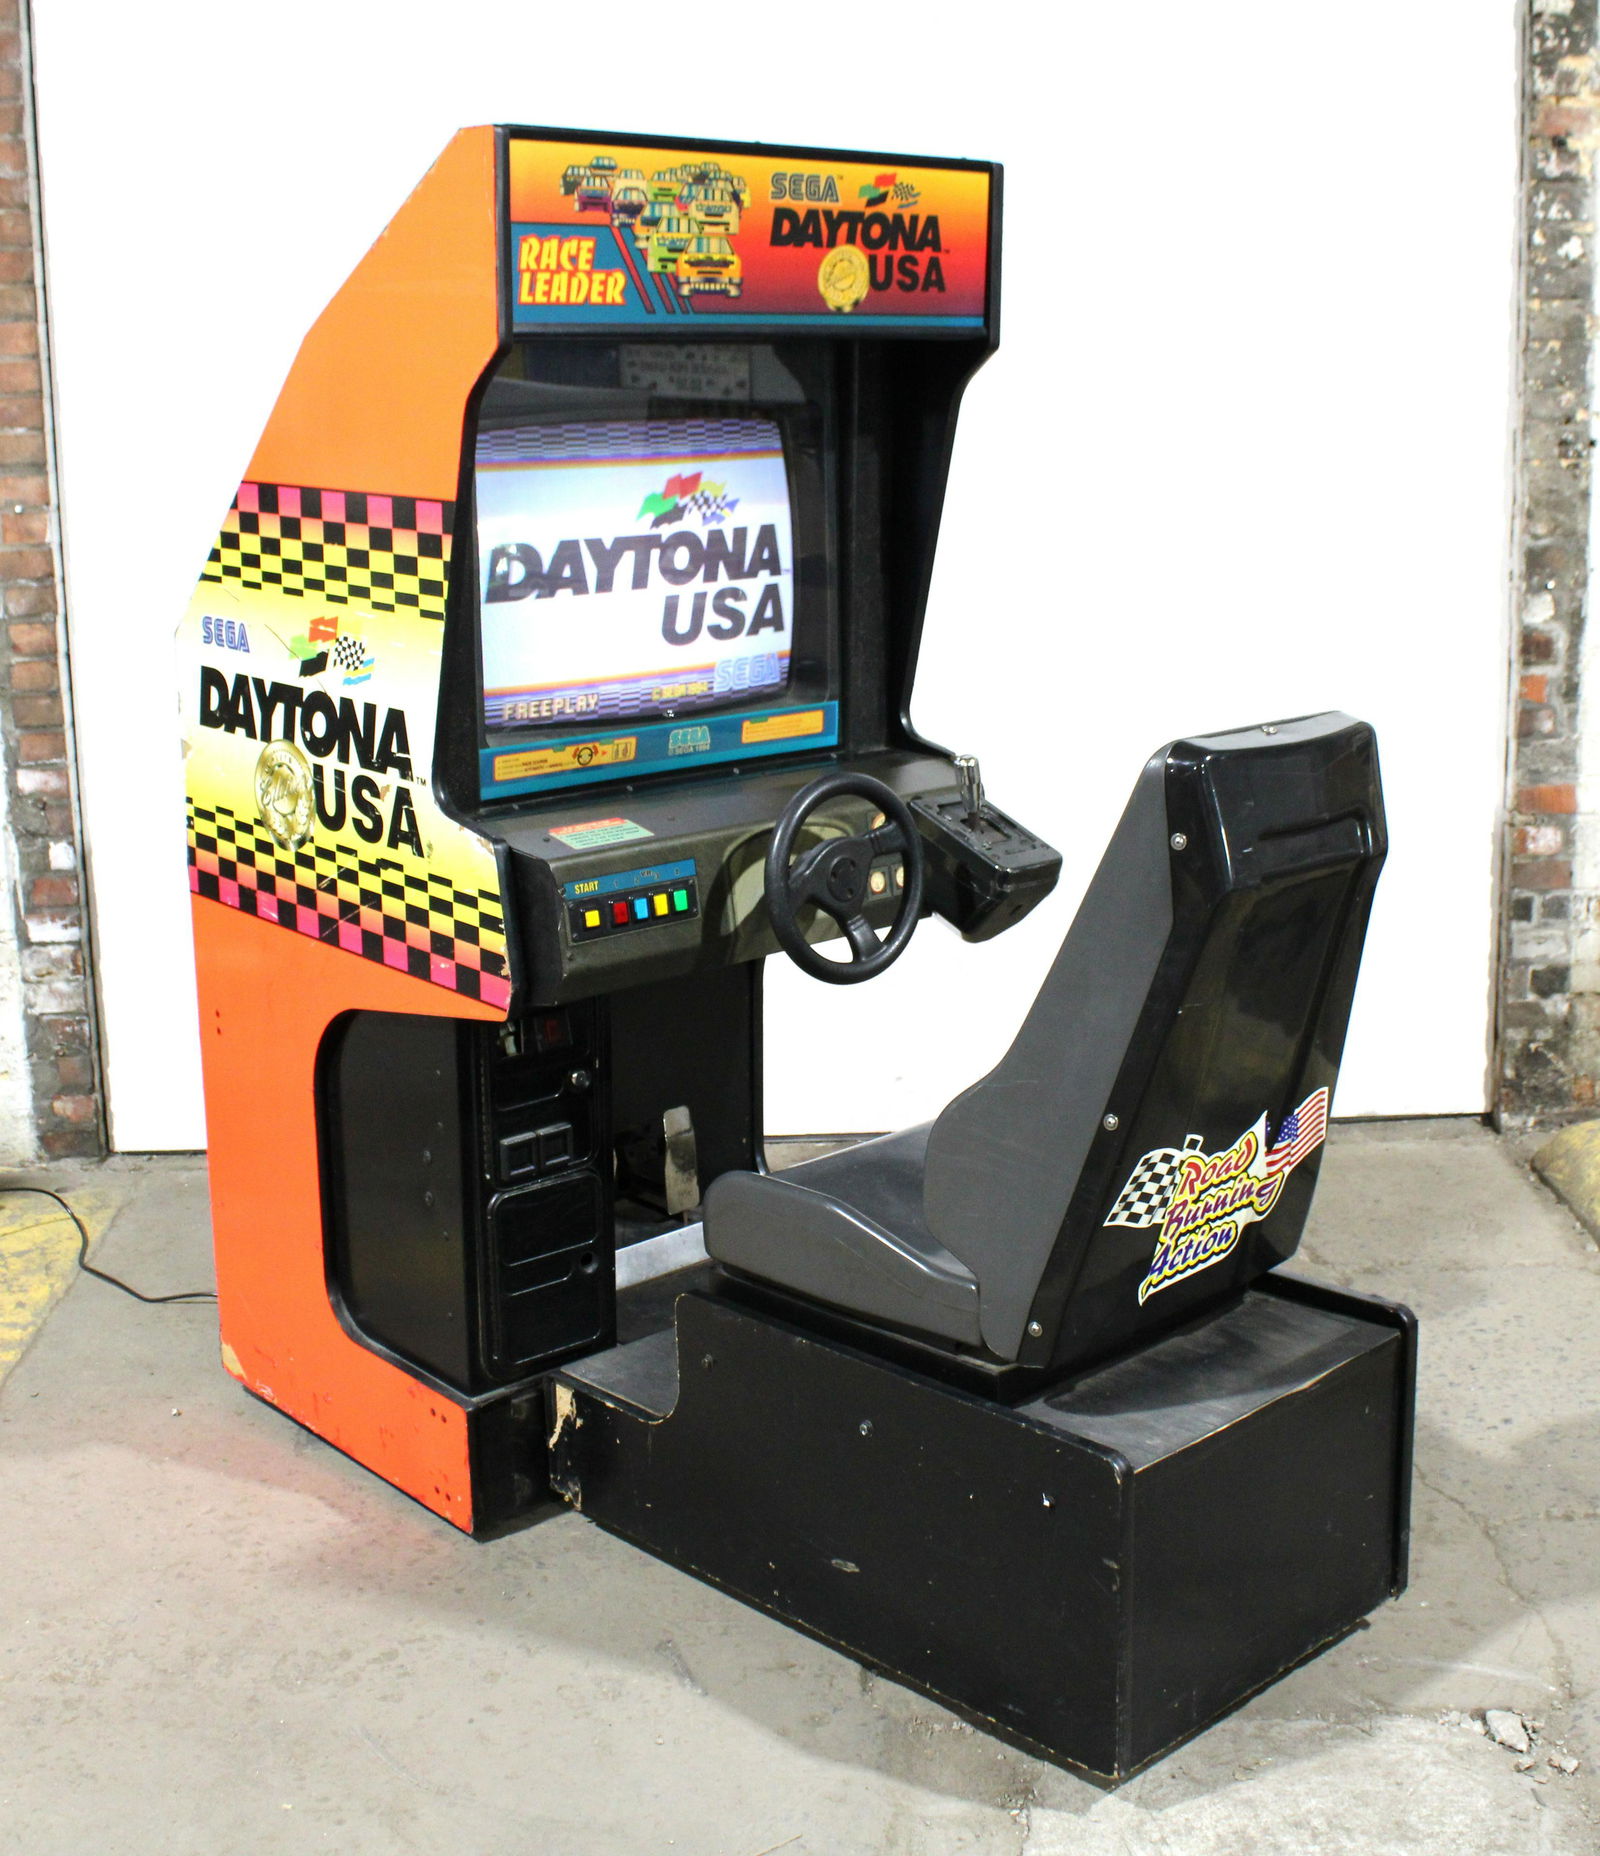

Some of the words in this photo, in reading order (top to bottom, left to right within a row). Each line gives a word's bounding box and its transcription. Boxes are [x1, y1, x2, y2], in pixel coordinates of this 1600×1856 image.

[770, 172, 840, 204] SEGA
[519, 235, 596, 271] RACE
[770, 207, 942, 253] DAYTONA
[518, 270, 626, 304] LEADER
[869, 255, 946, 292] USA
[485, 524, 782, 604] DAYTONA
[202, 616, 250, 653] SEGA
[661, 583, 785, 646] USA
[714, 653, 781, 691] SEGA
[200, 665, 414, 782] DAYTONA
[312, 763, 425, 858] USA
[574, 880, 599, 895] START
[1177, 1134, 1256, 1197] Road
[1162, 1174, 1280, 1241] Burning
[1148, 1223, 1234, 1280] Action
